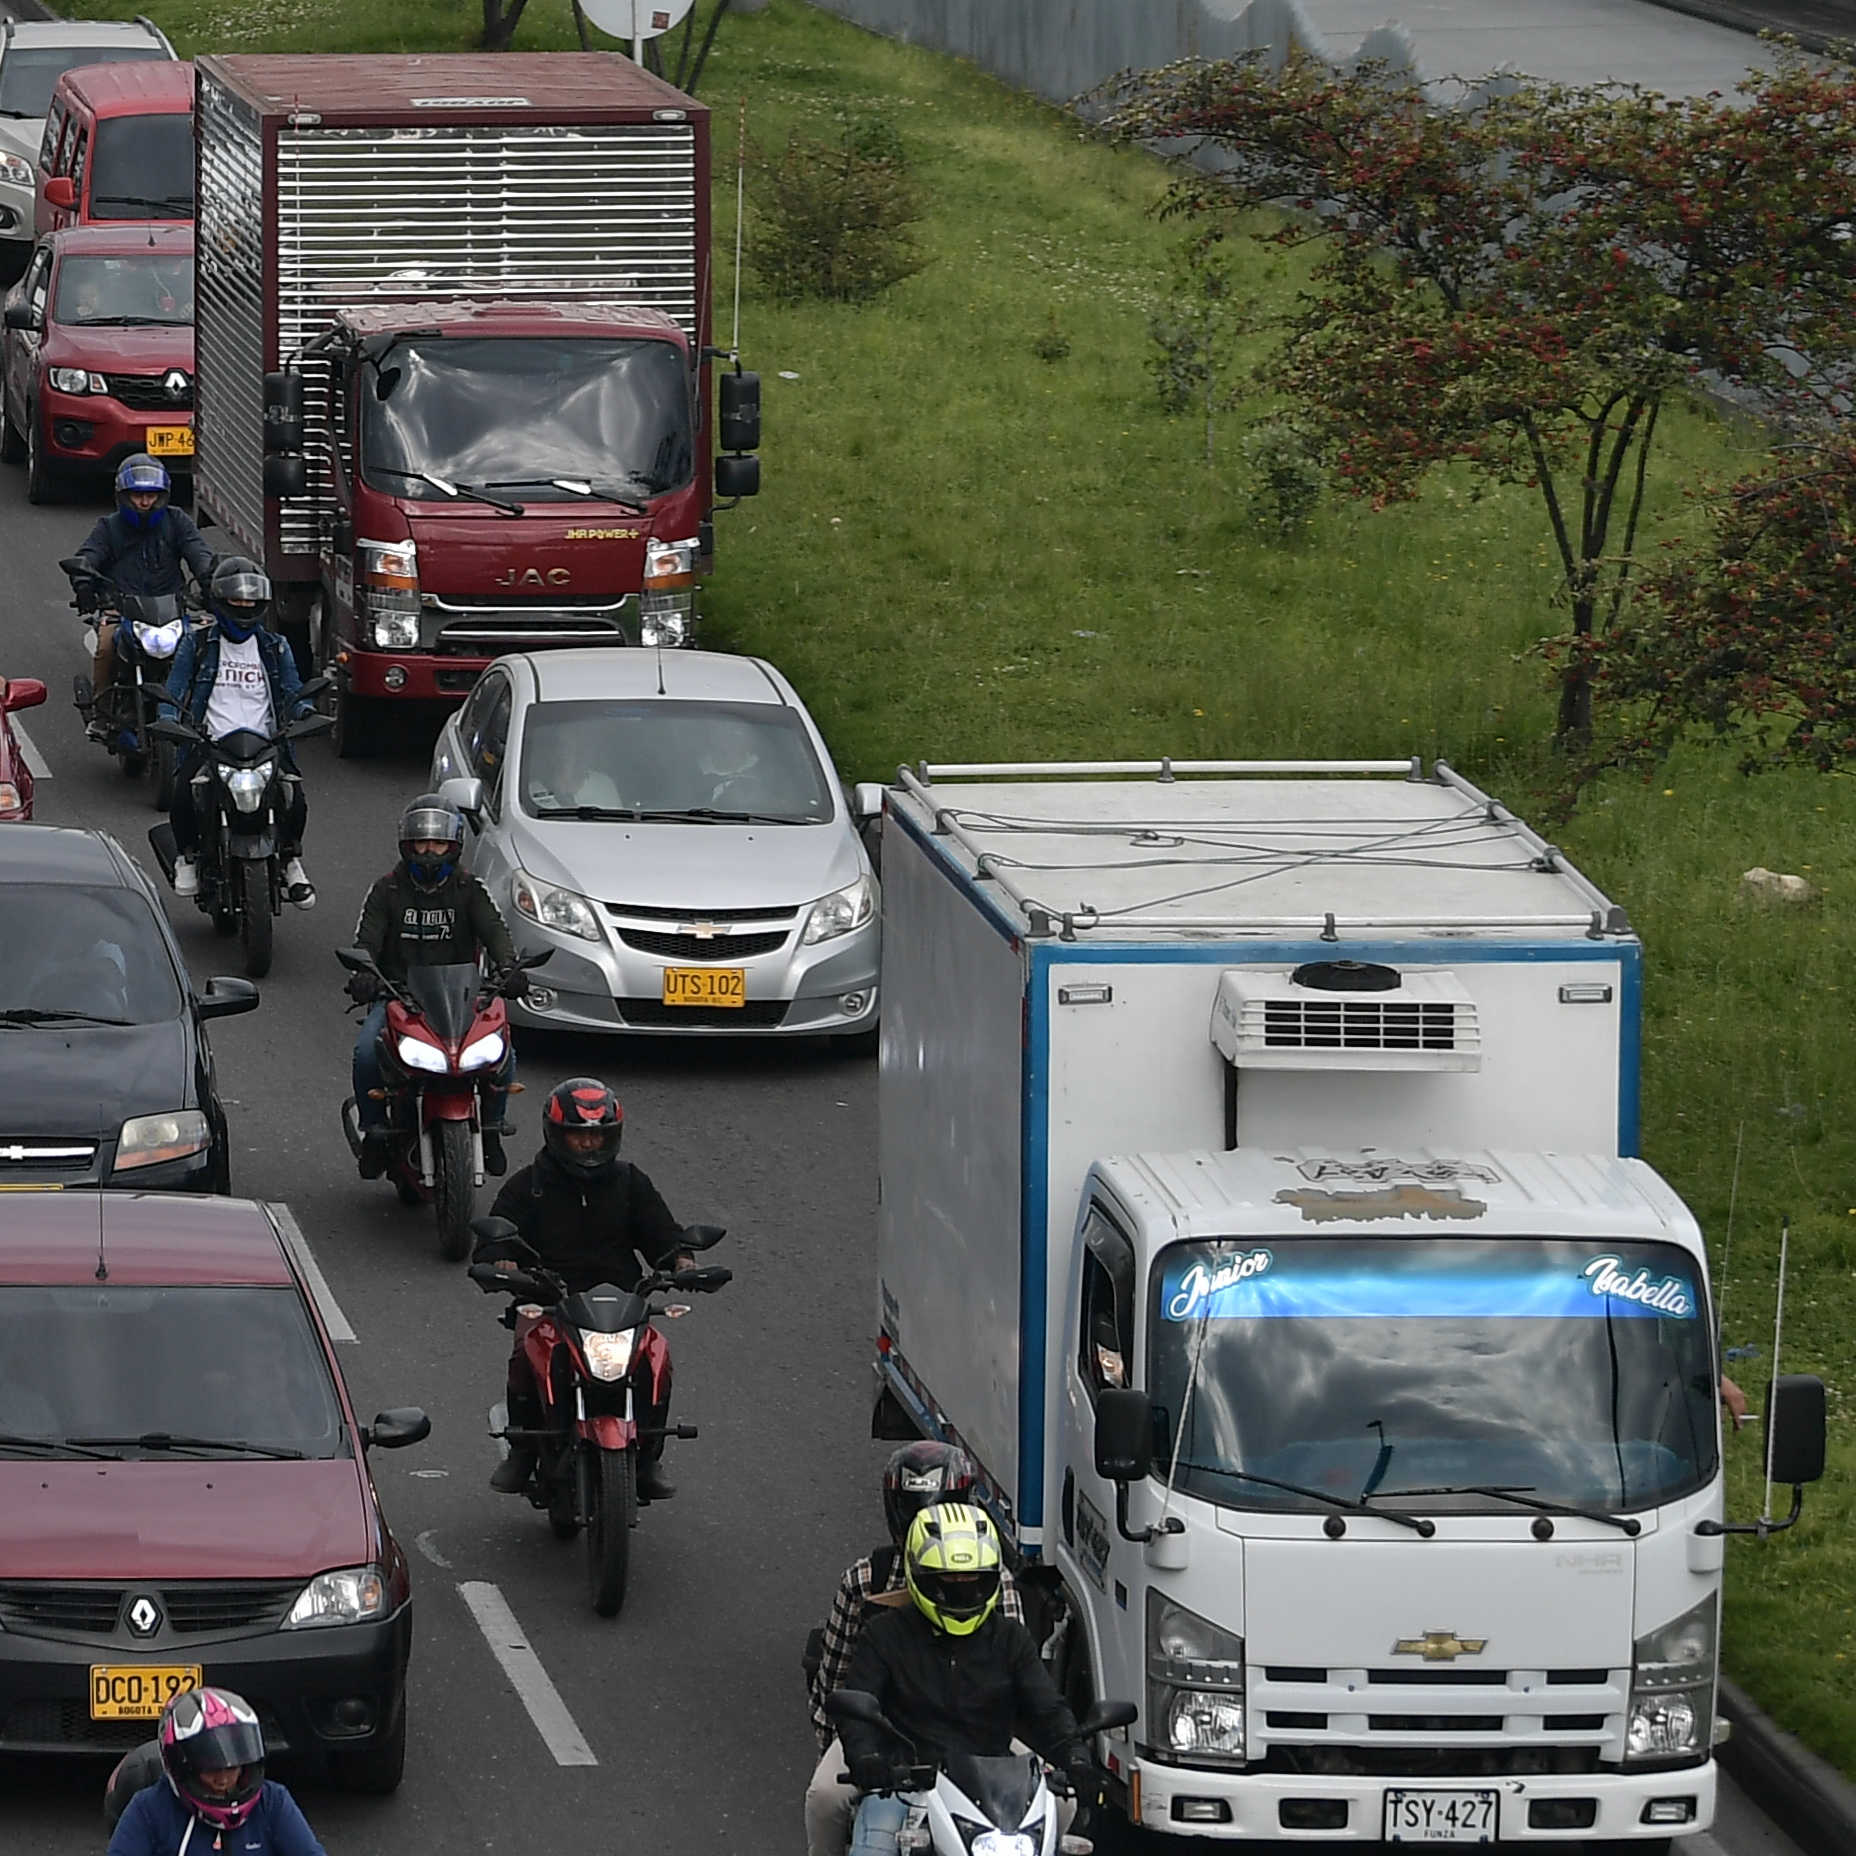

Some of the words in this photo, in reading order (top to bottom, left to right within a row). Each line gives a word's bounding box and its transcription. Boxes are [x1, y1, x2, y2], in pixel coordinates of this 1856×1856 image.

[495, 568, 571, 586] JAC
[1169, 1251, 1270, 1318] Junior
[1583, 1256, 1690, 1317] Isabella
[118, 1706, 152, 1715] BOGOTA
[1424, 1830, 1455, 1839] FUNZA
